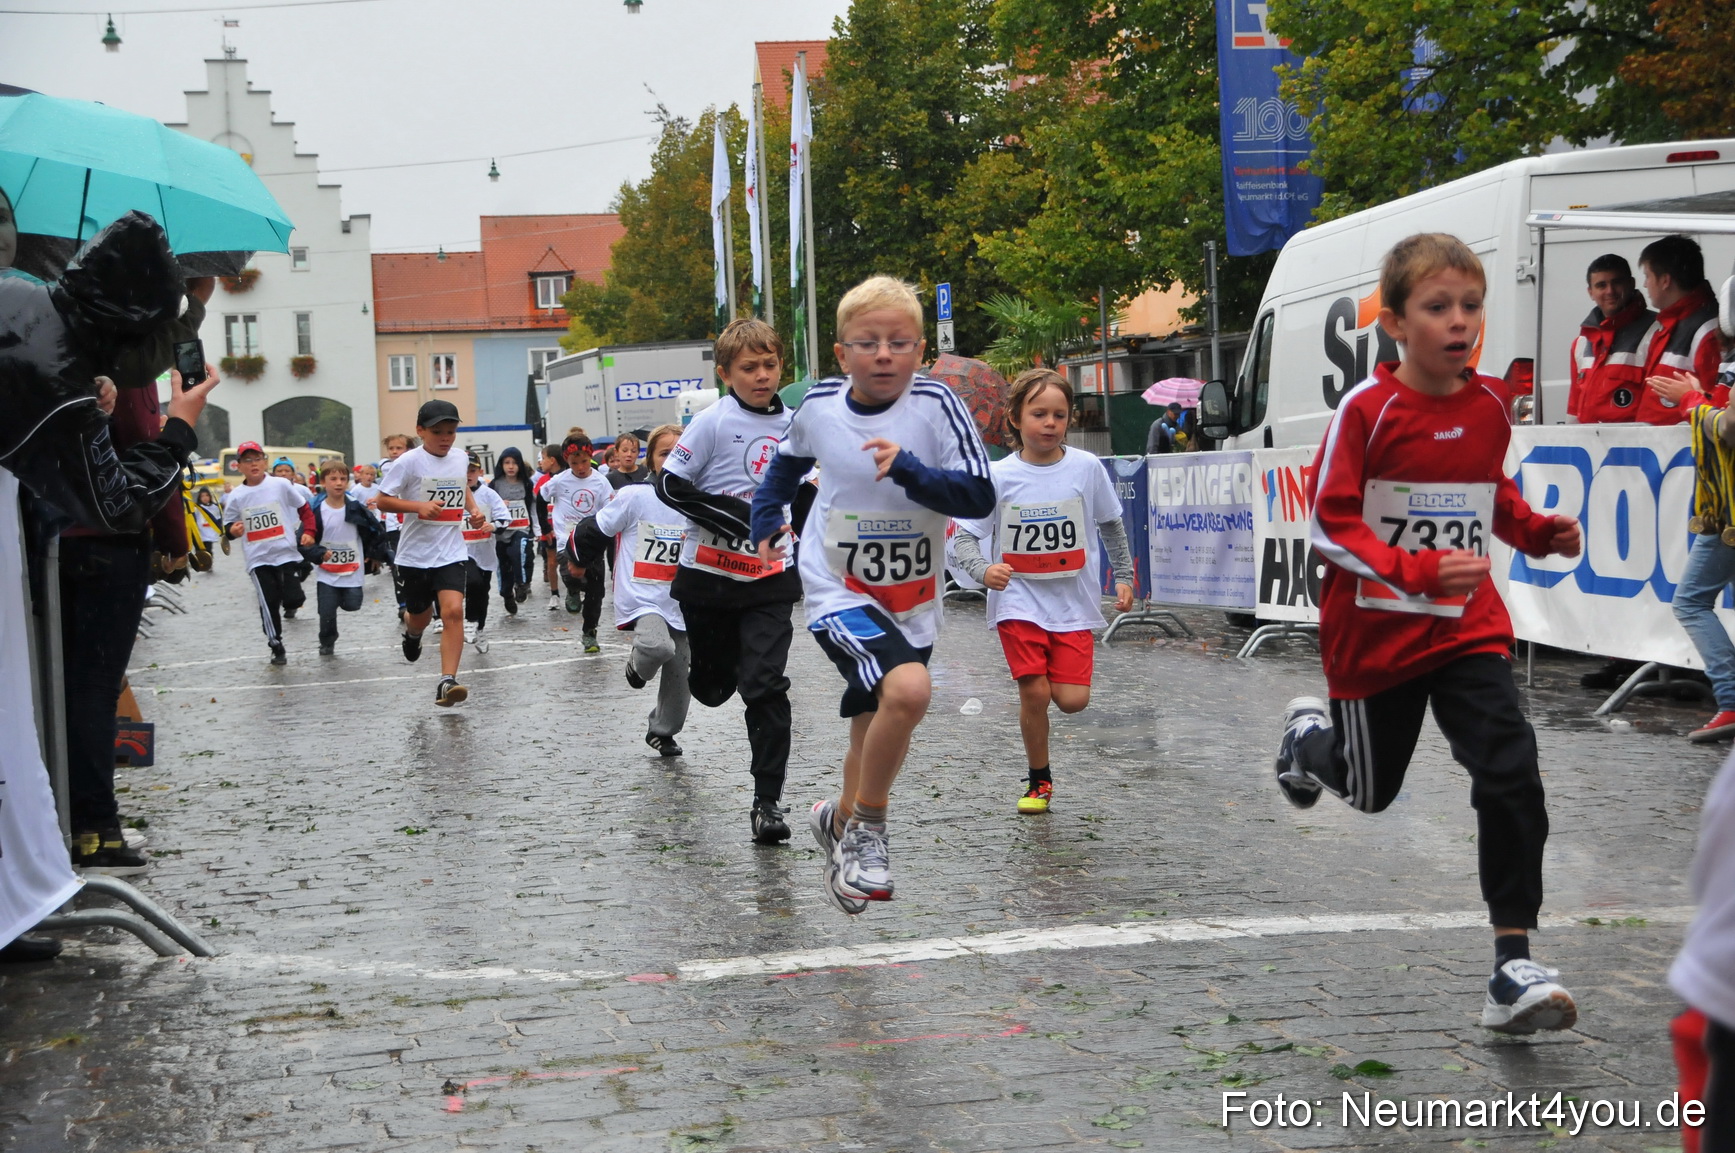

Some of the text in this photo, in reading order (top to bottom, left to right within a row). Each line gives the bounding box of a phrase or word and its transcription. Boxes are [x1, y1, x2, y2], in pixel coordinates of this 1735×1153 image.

[939, 288, 948, 316] P
[615, 378, 703, 402] BOCK
[1434, 429, 1460, 440] JAKO
[427, 490, 464, 508] 7322
[1409, 493, 1466, 508] BOCK
[245, 512, 279, 531] 7306
[1020, 507, 1059, 518] BOCK
[858, 519, 913, 532] BOCK
[1008, 520, 1077, 552] 7299
[1380, 516, 1482, 557] 7336
[331, 550, 356, 564] 335
[644, 538, 682, 564] 729
[837, 537, 932, 583] 7359
[716, 553, 765, 576] Thomas
